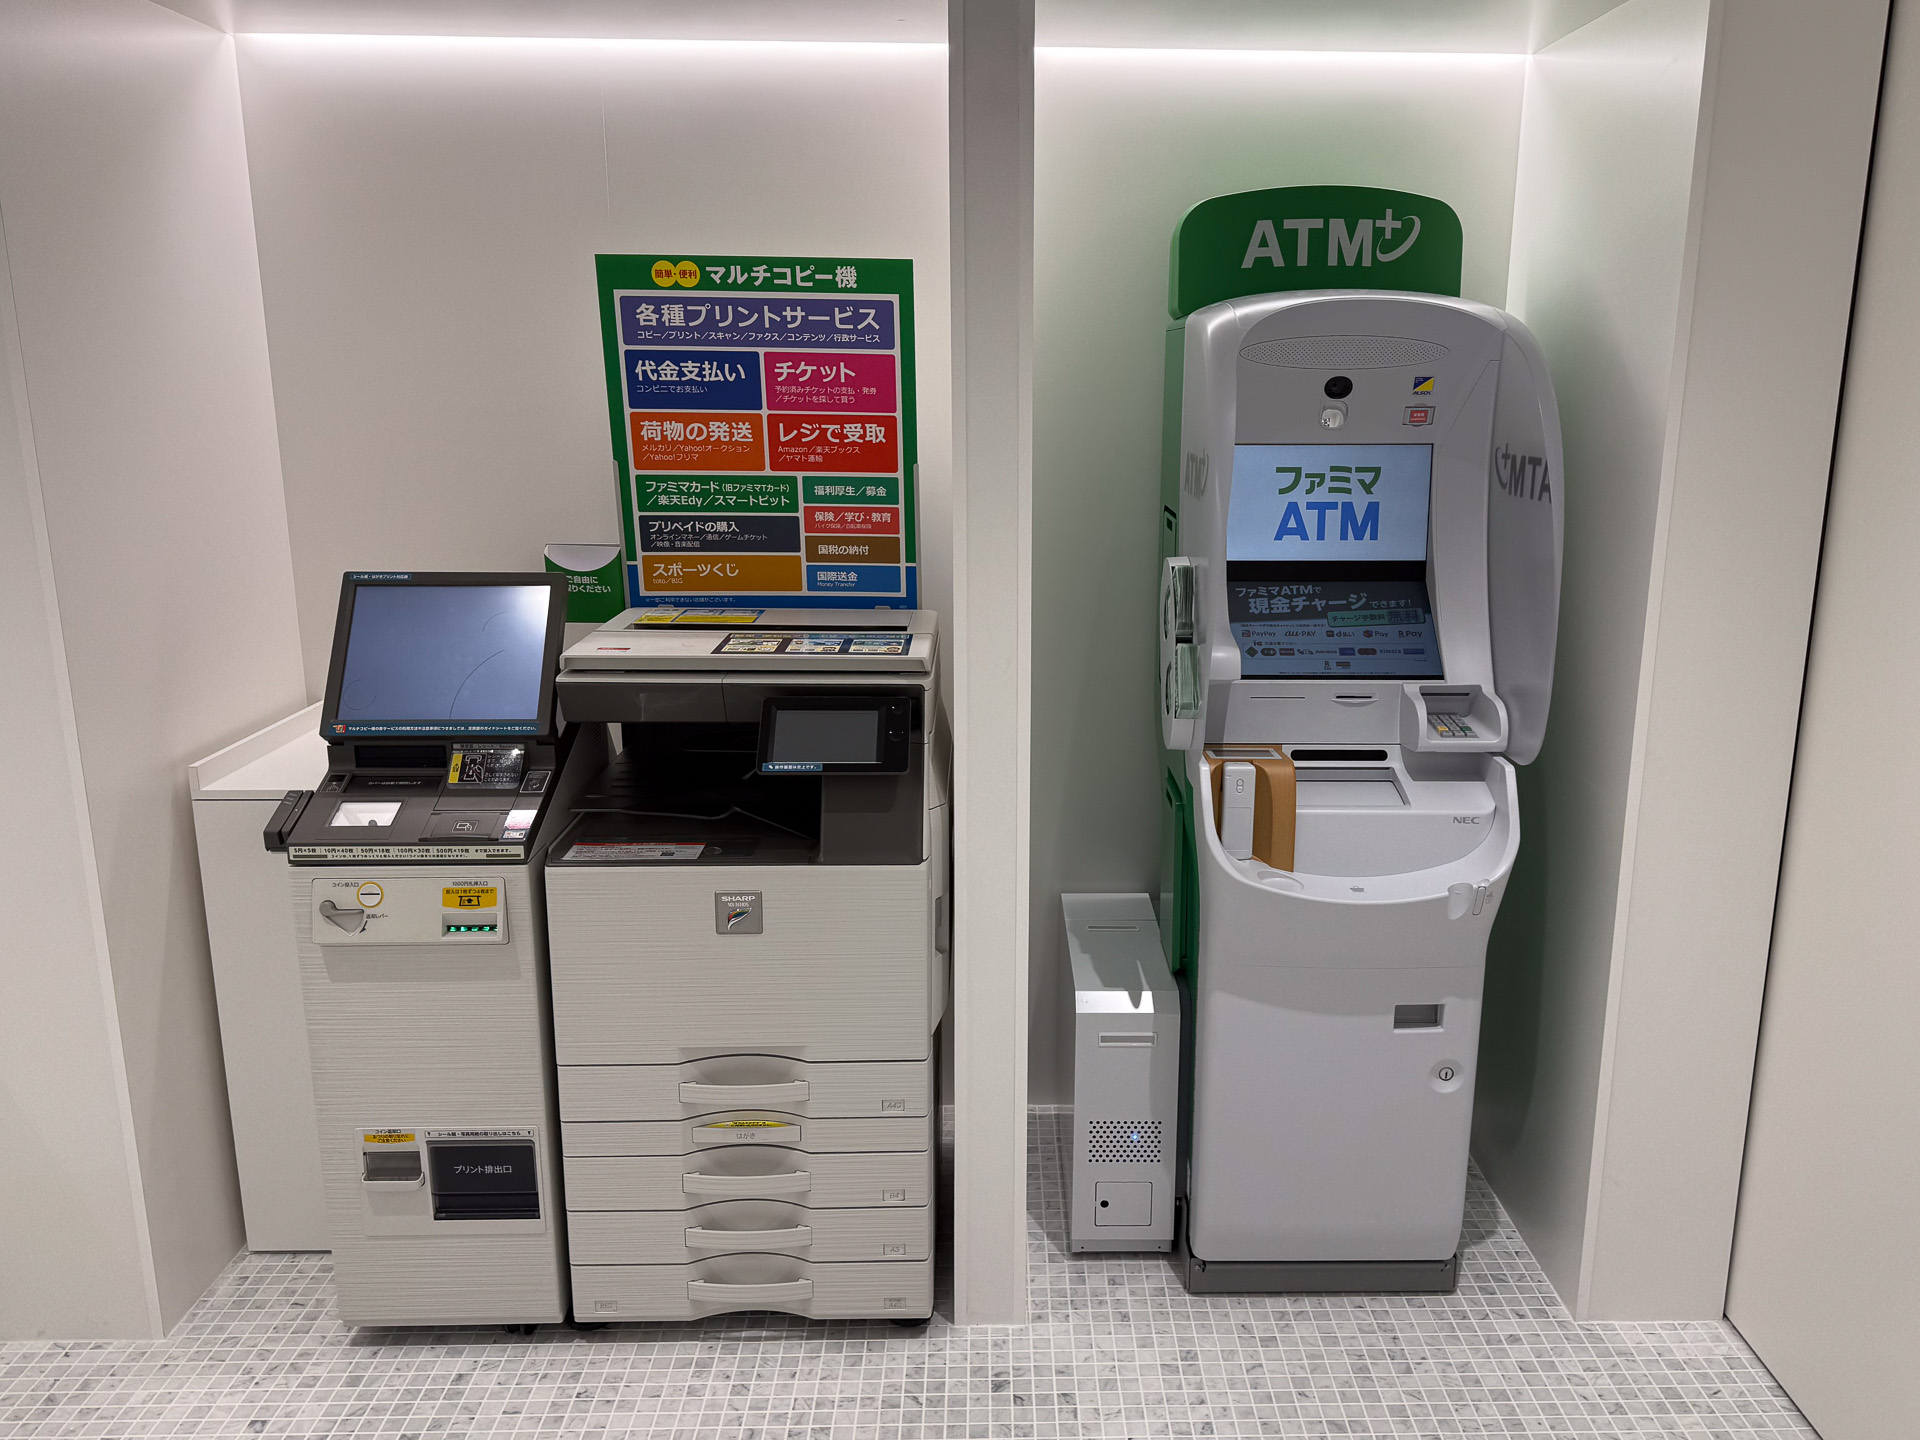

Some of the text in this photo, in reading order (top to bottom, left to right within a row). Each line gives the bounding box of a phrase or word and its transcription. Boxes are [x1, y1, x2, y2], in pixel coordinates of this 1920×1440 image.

[654, 268, 698, 280] 簡単・便利
[705, 265, 858, 288] マルチコピー機
[635, 303, 880, 330] 各種プリントサービス
[635, 360, 746, 382] 代金支払い
[774, 361, 856, 383] チケット
[636, 385, 708, 394] コンビニでお支払い
[640, 420, 754, 442] 荷物の発送
[778, 422, 887, 444] レジで受取
[641, 444, 750, 453] メルカリ／Yahoo!オークション
[778, 445, 861, 454] Amazon／楽天ブックス
[1275, 465, 1382, 495] ファミマ
[814, 485, 887, 496] 福利厚生／募金
[814, 511, 891, 523] 保険／学び・教育
[1273, 501, 1380, 541] ATM
[648, 521, 740, 532] プリペイドの購入
[818, 544, 870, 555] 国税の納付
[652, 562, 740, 577] スポーツくじ
[816, 571, 858, 581] 国際送金
[1235, 584, 1322, 597] ファミマATMで
[1249, 592, 1367, 615] 現金チャージ
[1331, 613, 1386, 622] チャージ手数料
[1375, 630, 1389, 638] Pay
[1406, 630, 1423, 638] Pay
[1452, 816, 1480, 825] NEC
[453, 1165, 512, 1174] プリント排出口
